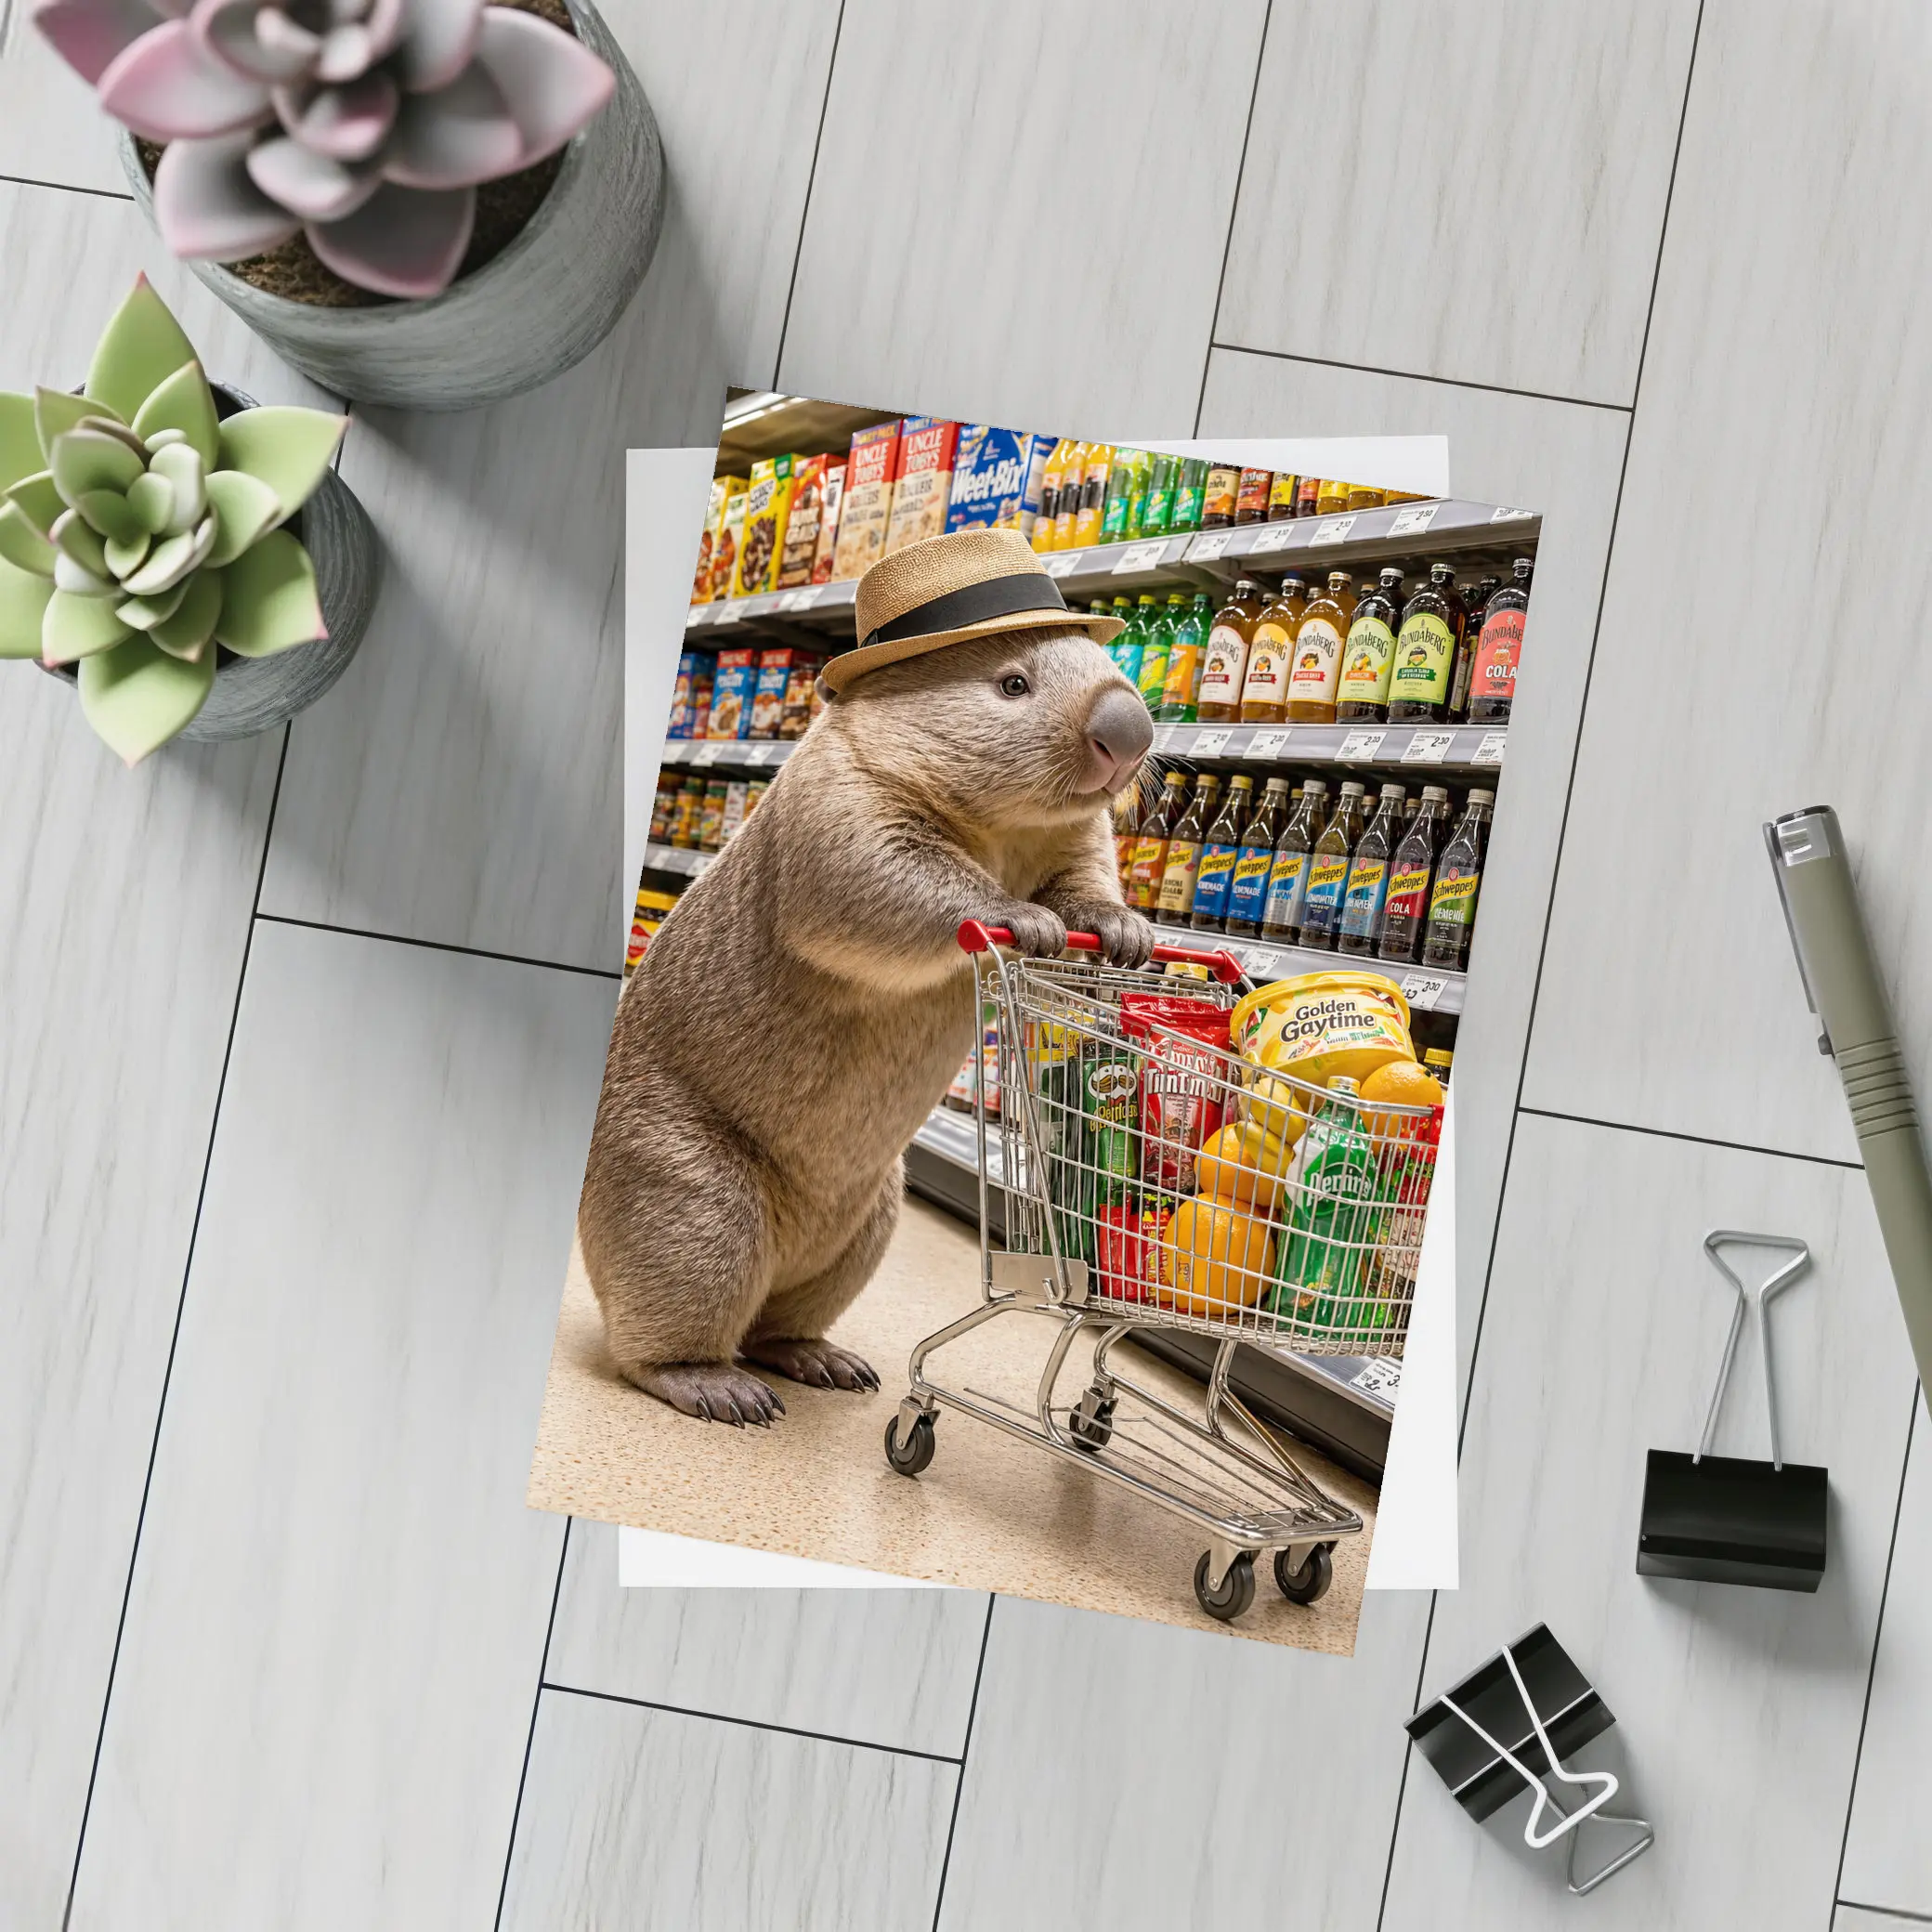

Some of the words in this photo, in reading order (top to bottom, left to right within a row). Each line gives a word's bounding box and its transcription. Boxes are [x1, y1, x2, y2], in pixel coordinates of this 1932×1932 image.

[907, 428, 944, 454] UNCLE
[855, 442, 890, 466] UNCLE
[949, 457, 1025, 505] Weet-Bix
[1399, 627, 1446, 656] BUNDABERG
[1481, 624, 1523, 650] BUNDABE
[1485, 664, 1518, 679] COLA
[1309, 867, 1345, 885] Schweppes
[1388, 874, 1427, 896] Schweppes
[1432, 880, 1474, 903] Schweppes
[1390, 902, 1411, 915] COLA
[1296, 999, 1356, 1021] Golden
[1281, 1012, 1375, 1042] Gaytime
